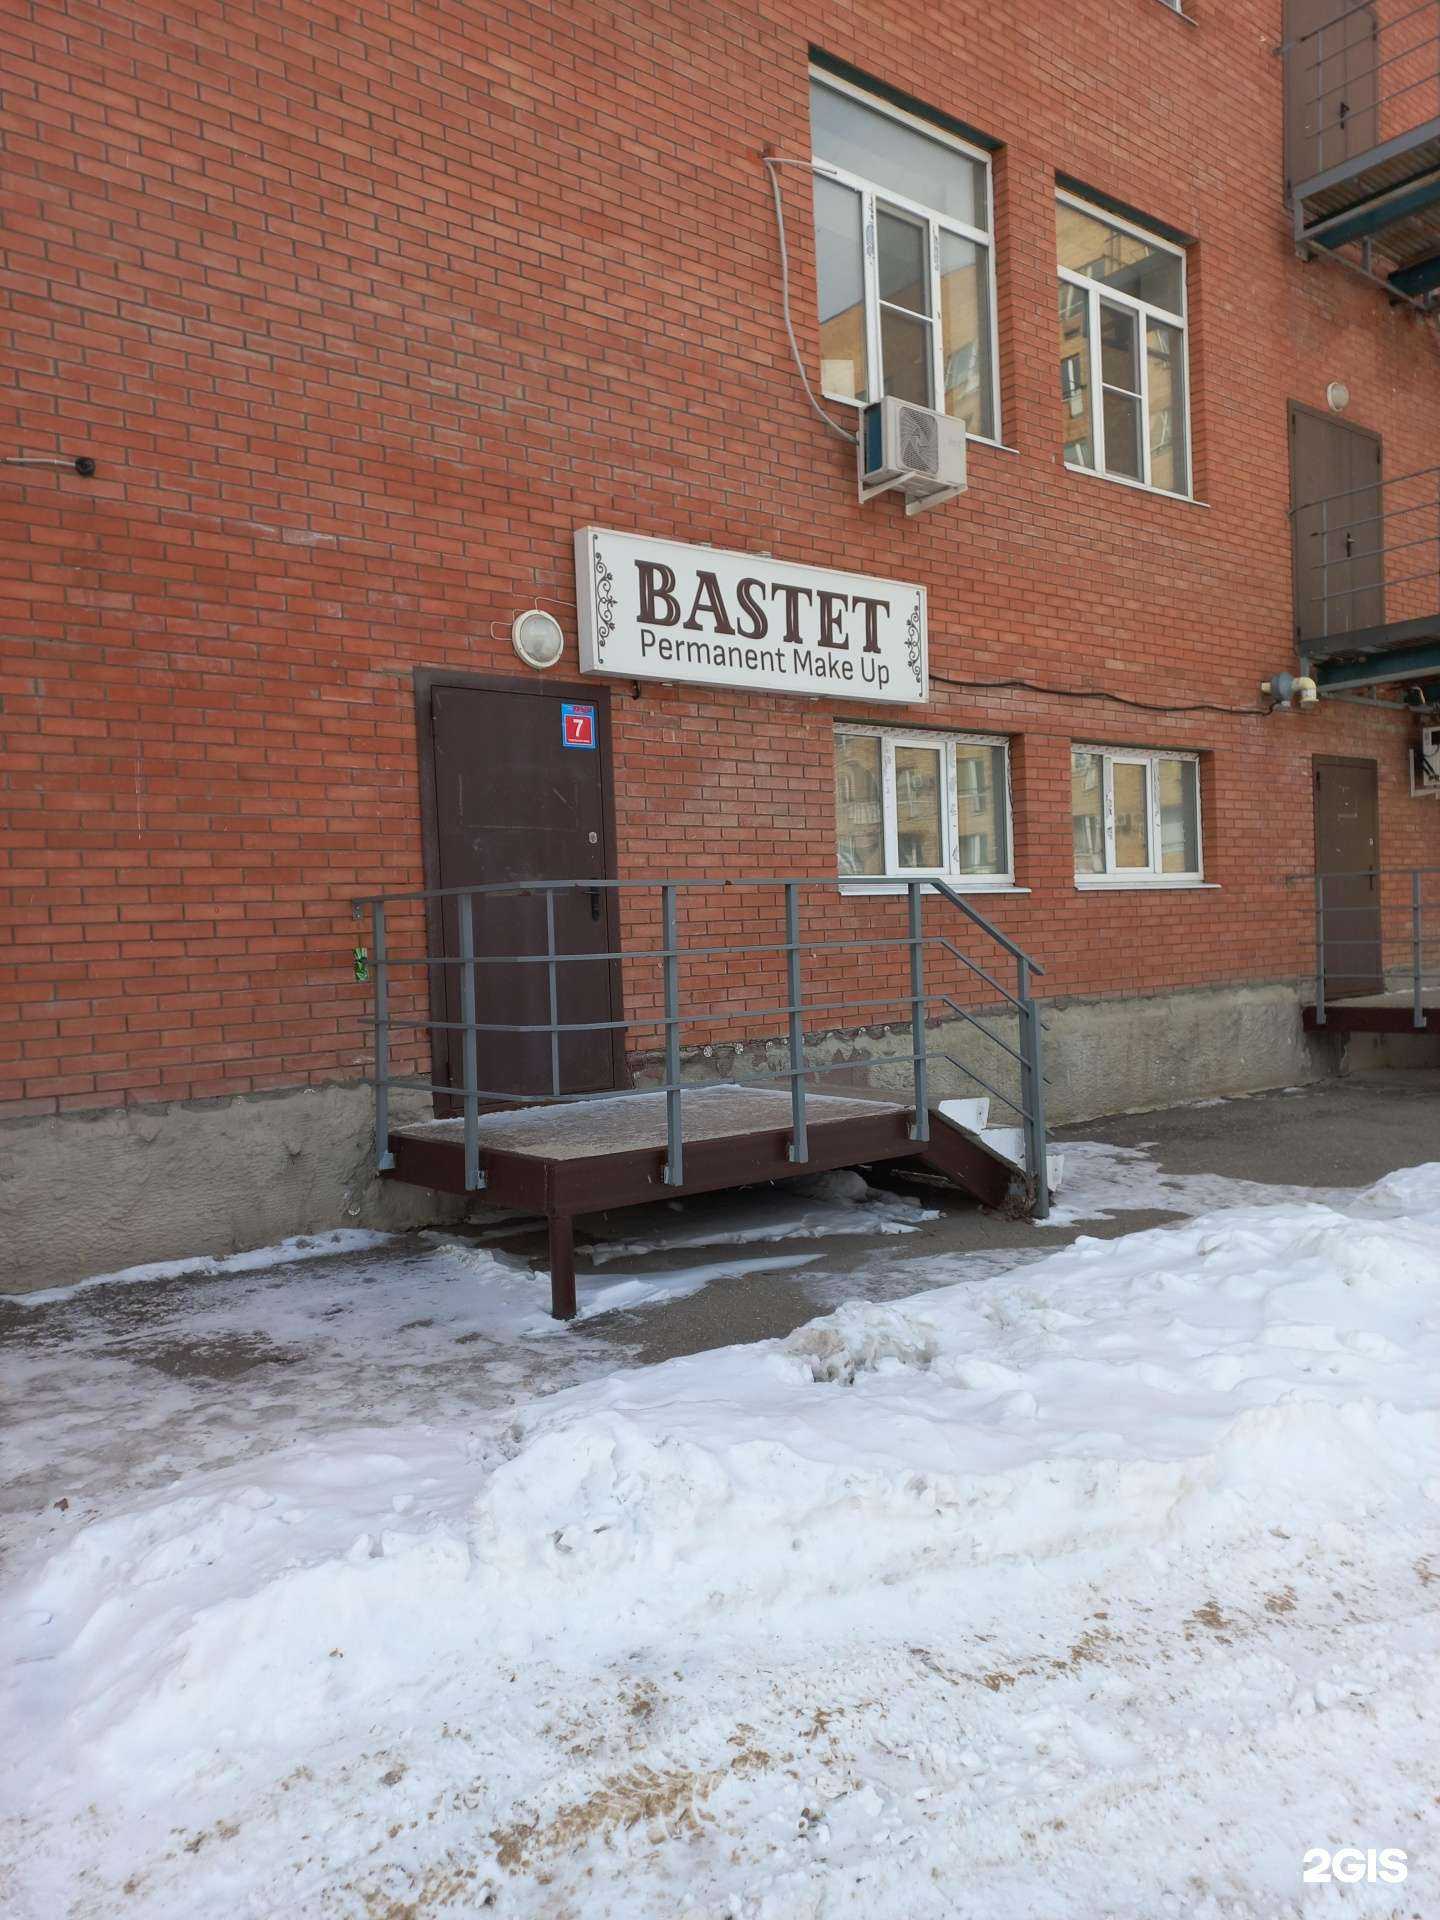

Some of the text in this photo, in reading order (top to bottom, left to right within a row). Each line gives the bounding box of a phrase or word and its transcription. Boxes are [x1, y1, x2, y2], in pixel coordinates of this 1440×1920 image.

[635, 559, 890, 653] BASTET
[641, 629, 890, 689] Permanent Make Up
[572, 718, 584, 737] 7
